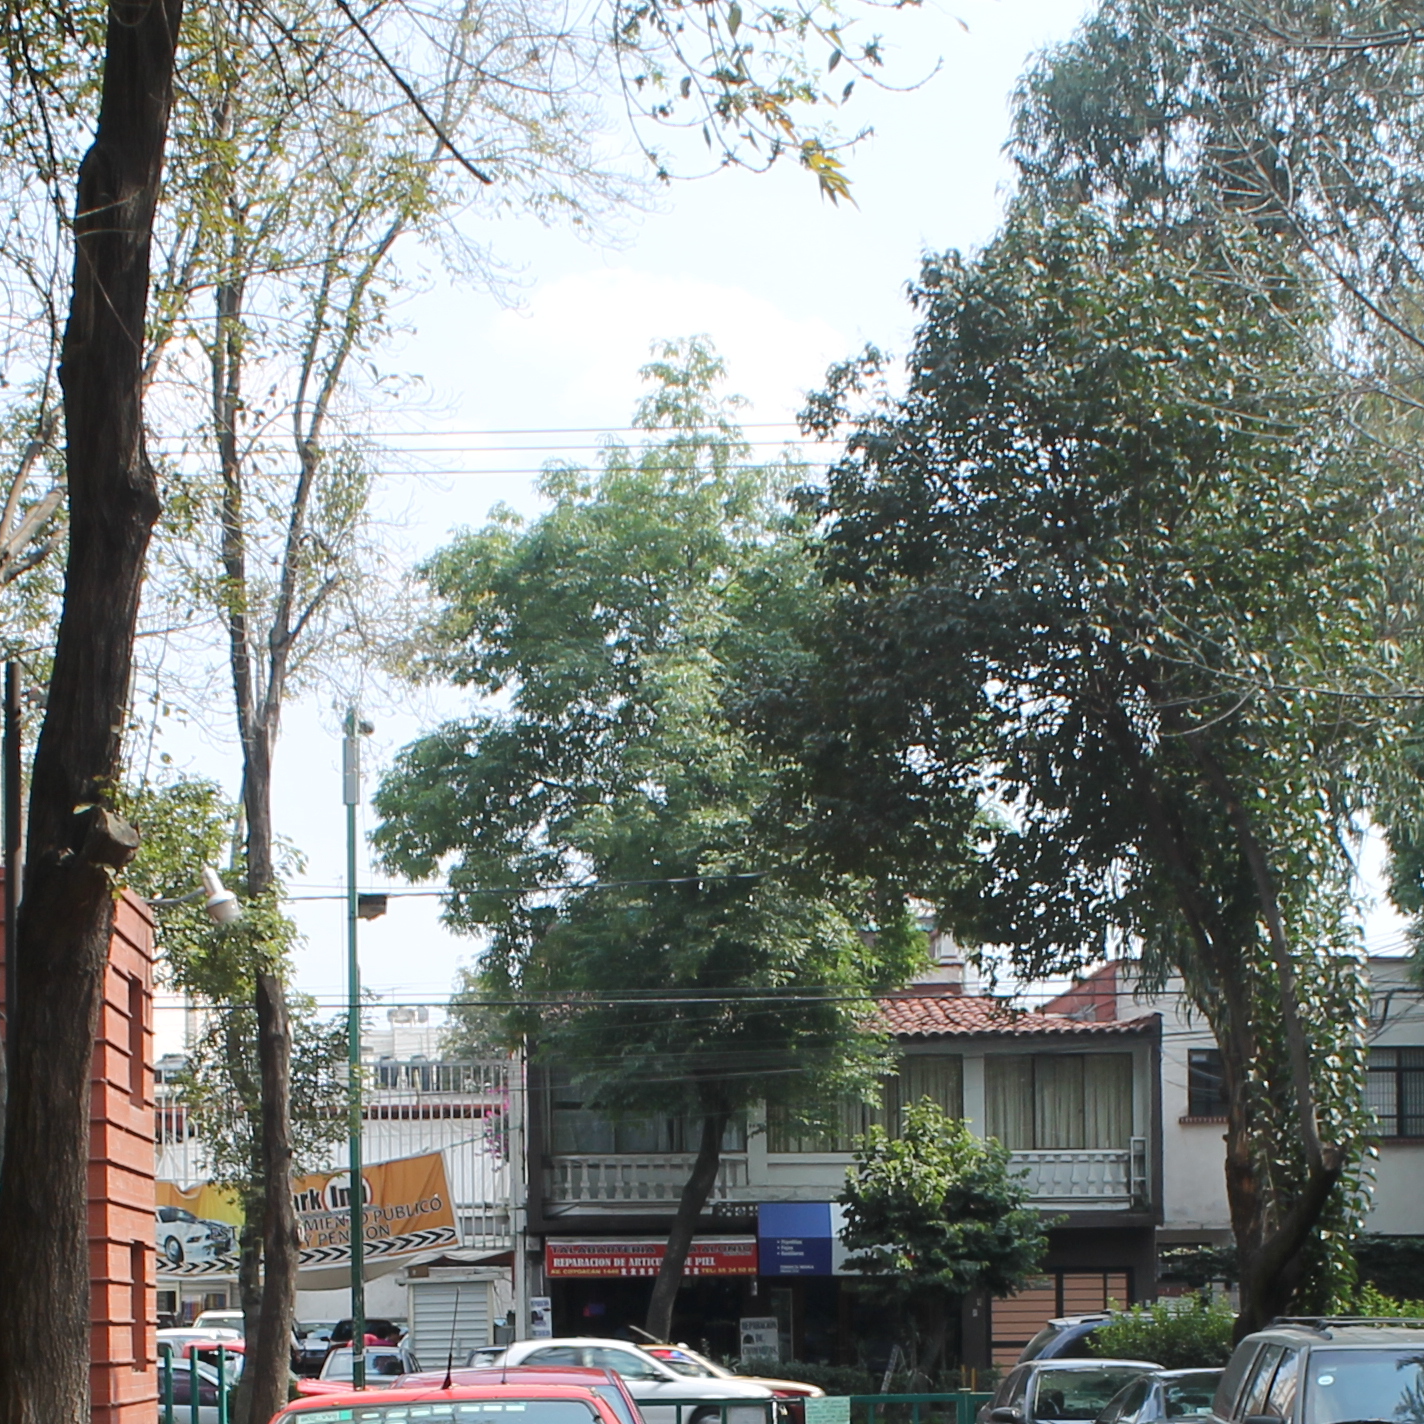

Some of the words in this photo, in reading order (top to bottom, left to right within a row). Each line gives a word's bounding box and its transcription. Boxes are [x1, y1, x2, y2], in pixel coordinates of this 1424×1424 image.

[319, 1225, 390, 1245] PENON
[553, 1257, 611, 1267] REPARACION
[614, 1257, 625, 1267] DE
[628, 1257, 663, 1267] ARTICU
